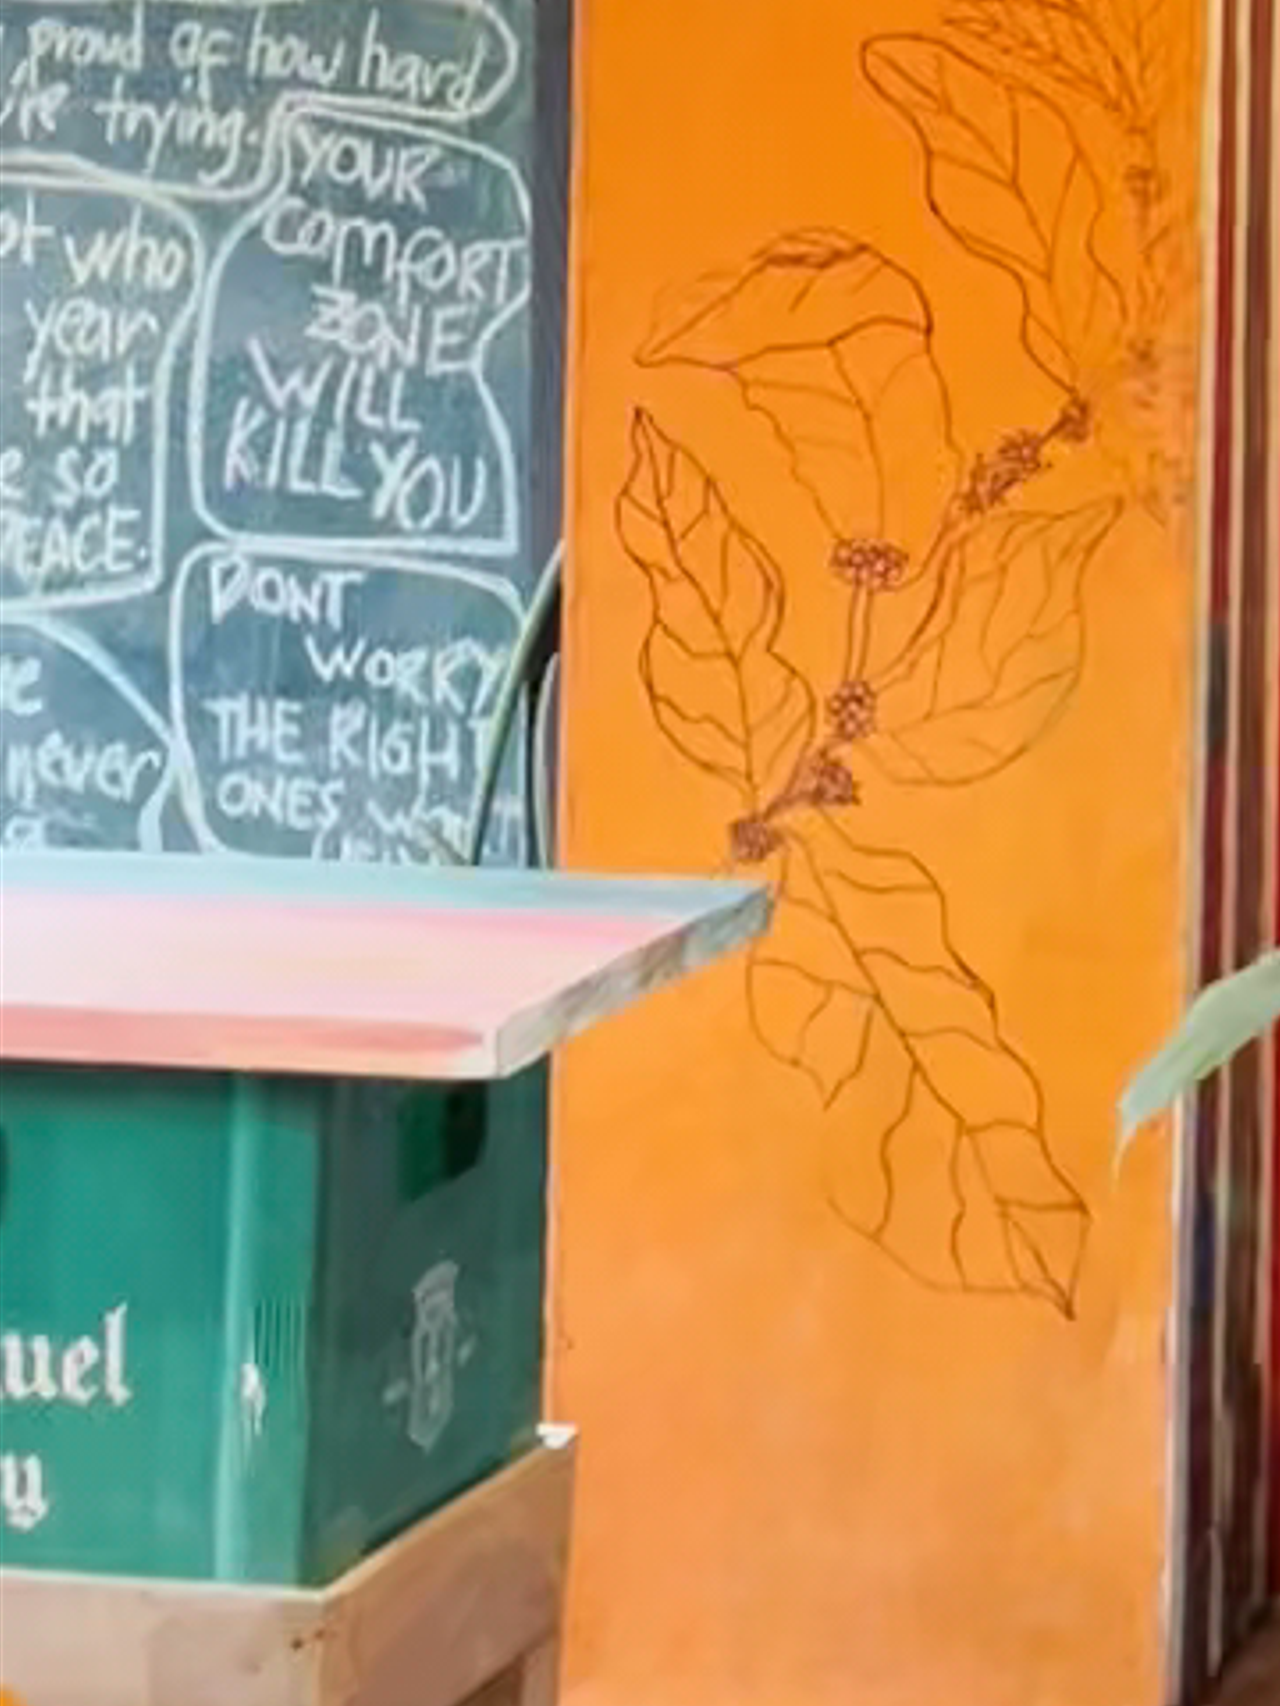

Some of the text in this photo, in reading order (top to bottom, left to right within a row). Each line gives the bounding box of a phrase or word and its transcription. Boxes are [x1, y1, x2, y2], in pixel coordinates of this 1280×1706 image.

[247, 6, 347, 93] how
[358, 7, 483, 114] hard
[300, 123, 443, 212] YOUR
[64, 203, 186, 289] who
[22, 296, 158, 386] year
[305, 285, 477, 376] ZONE
[26, 361, 146, 446] that
[248, 336, 420, 433] WILL
[52, 446, 119, 508] so
[225, 394, 362, 500] KILL
[368, 438, 486, 532] YOU
[201, 691, 303, 764] THE
[217, 772, 347, 834] ONES
